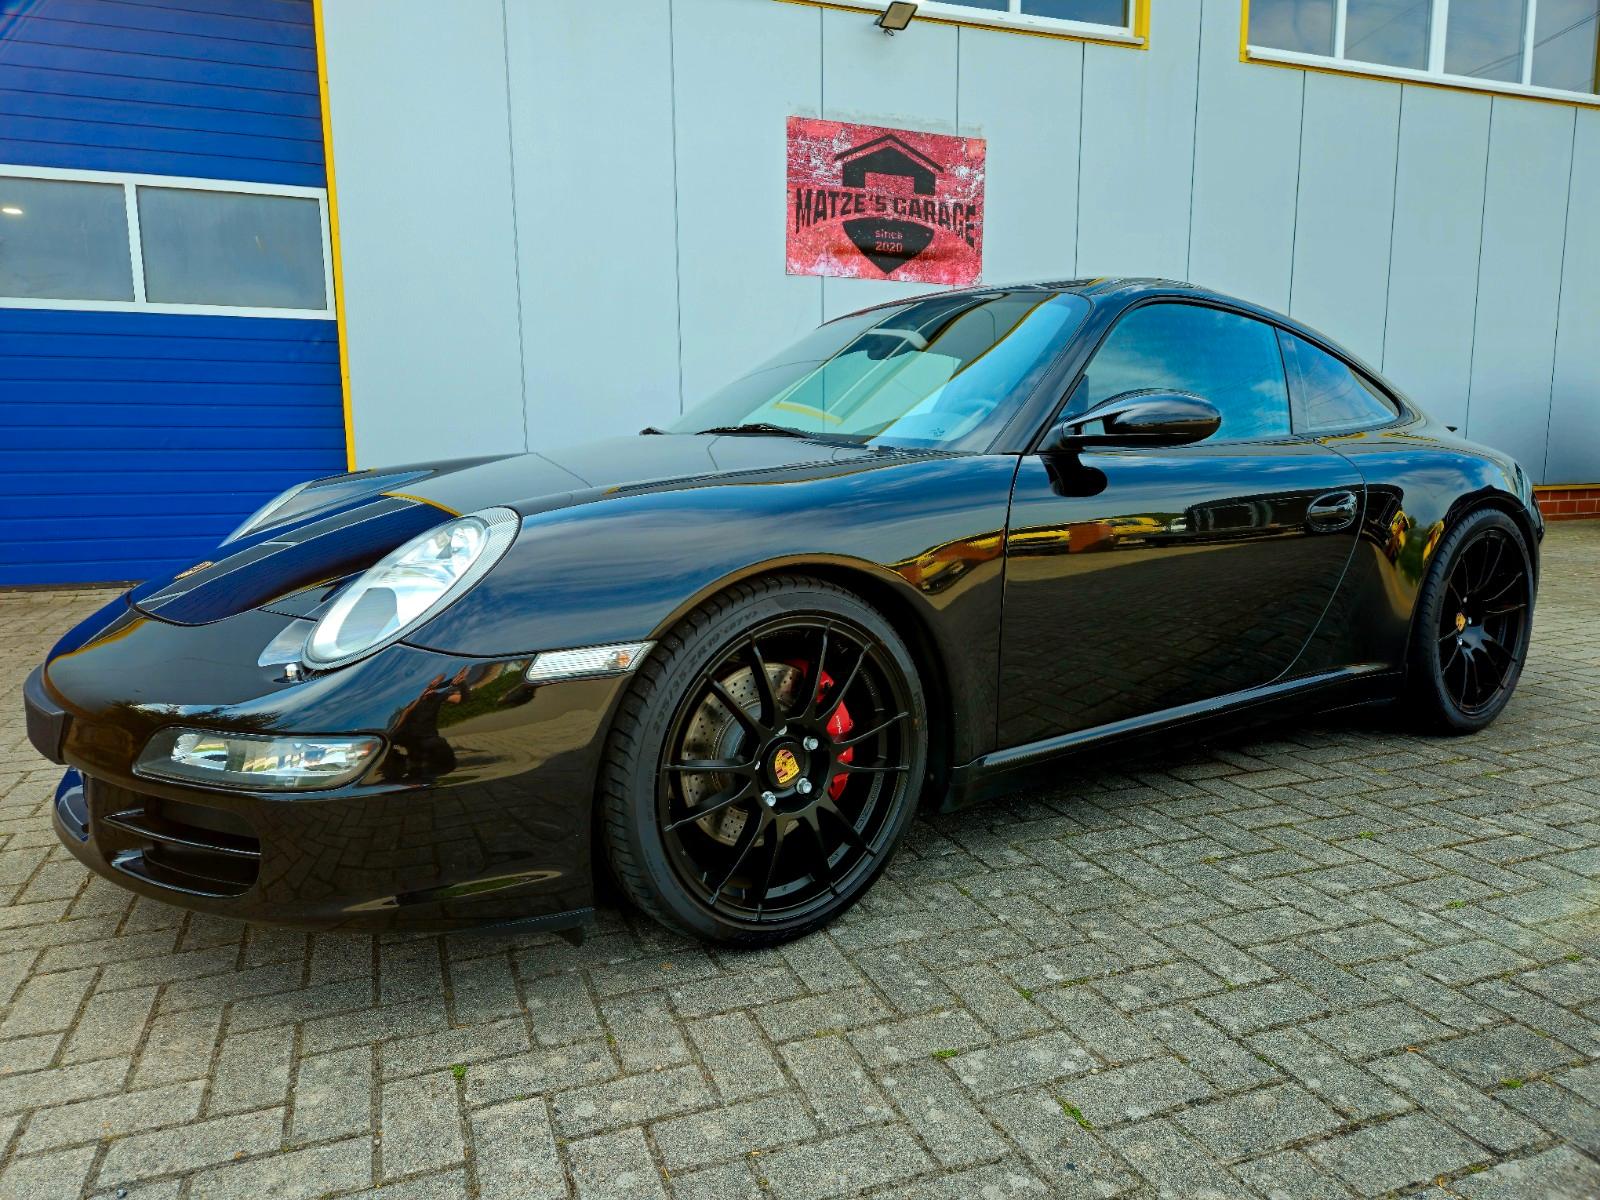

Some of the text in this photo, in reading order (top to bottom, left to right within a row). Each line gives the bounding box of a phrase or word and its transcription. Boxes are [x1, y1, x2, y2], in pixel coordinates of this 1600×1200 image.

[795, 187, 976, 248] MATZE'S GARAGE
[874, 228, 904, 240] since
[874, 241, 904, 252] 2020
